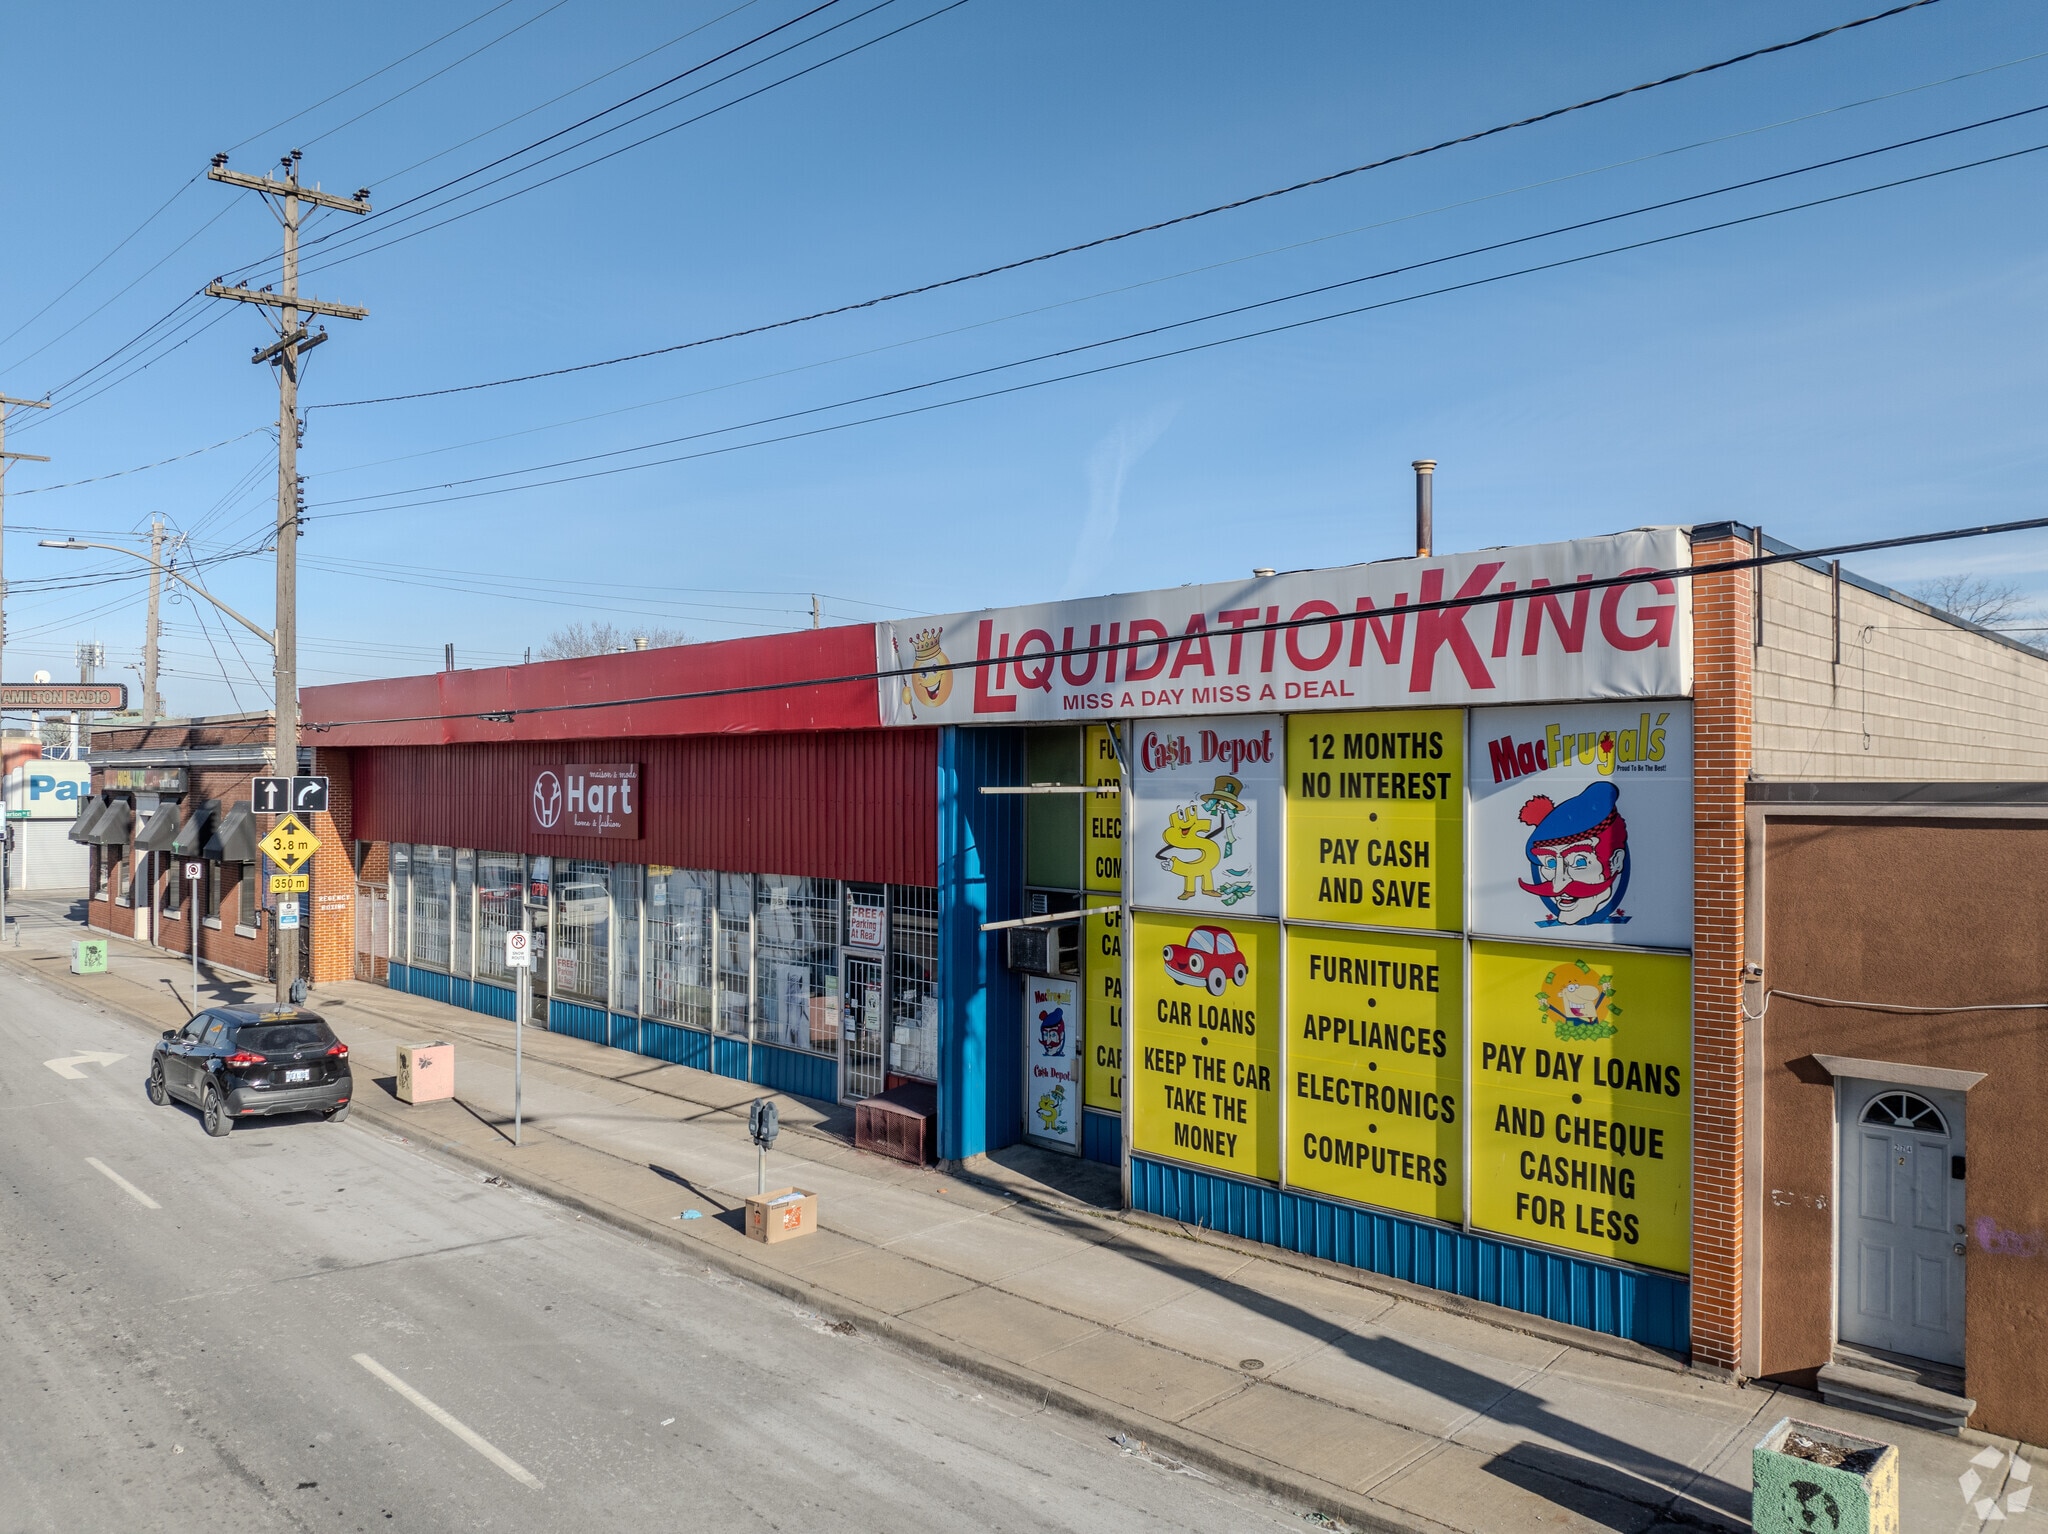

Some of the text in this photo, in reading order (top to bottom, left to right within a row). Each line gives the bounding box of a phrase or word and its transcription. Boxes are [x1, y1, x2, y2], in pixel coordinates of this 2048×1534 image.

[1, 690, 111, 704] AMILTON RADIO
[1063, 679, 1355, 711] MISS A DAY MISS A DEAL
[1198, 730, 1274, 775] Depot
[1309, 732, 1443, 759] 12 MONTHS
[590, 769, 612, 778] maison
[619, 764, 637, 779] mode
[1302, 772, 1451, 800] NO INTEREST
[568, 776, 632, 814] Hart
[574, 814, 590, 826] home
[599, 815, 621, 834] fashion
[273, 838, 294, 850] 3.8
[1320, 838, 1429, 868] PAY CASH
[275, 879, 305, 888] 350 m
[532, 883, 548, 896] OPEN
[1318, 876, 1430, 908] AND SAVE
[852, 906, 877, 919] FREE
[852, 918, 876, 932] Parking
[851, 929, 875, 940] At Rear
[557, 959, 574, 968] FREE
[1310, 954, 1439, 993] FURNITURE
[1158, 999, 1256, 1036] CAR LOANS
[1303, 1014, 1446, 1058] APPLIANCES
[1051, 1067, 1070, 1082] Depot
[1145, 1046, 1270, 1092] KEEP THE CAR
[1482, 1042, 1680, 1097] PAY DAY LOANS
[1164, 1084, 1247, 1124] TAKE THE
[1297, 1072, 1455, 1124] ELECTRONICS
[1175, 1122, 1237, 1158] MONEY
[1495, 1104, 1664, 1160] AND CHEQUE
[1303, 1133, 1447, 1187] COMPUTERS
[1520, 1150, 1635, 1200] CASHING
[1516, 1192, 1639, 1245] FOR LESS
